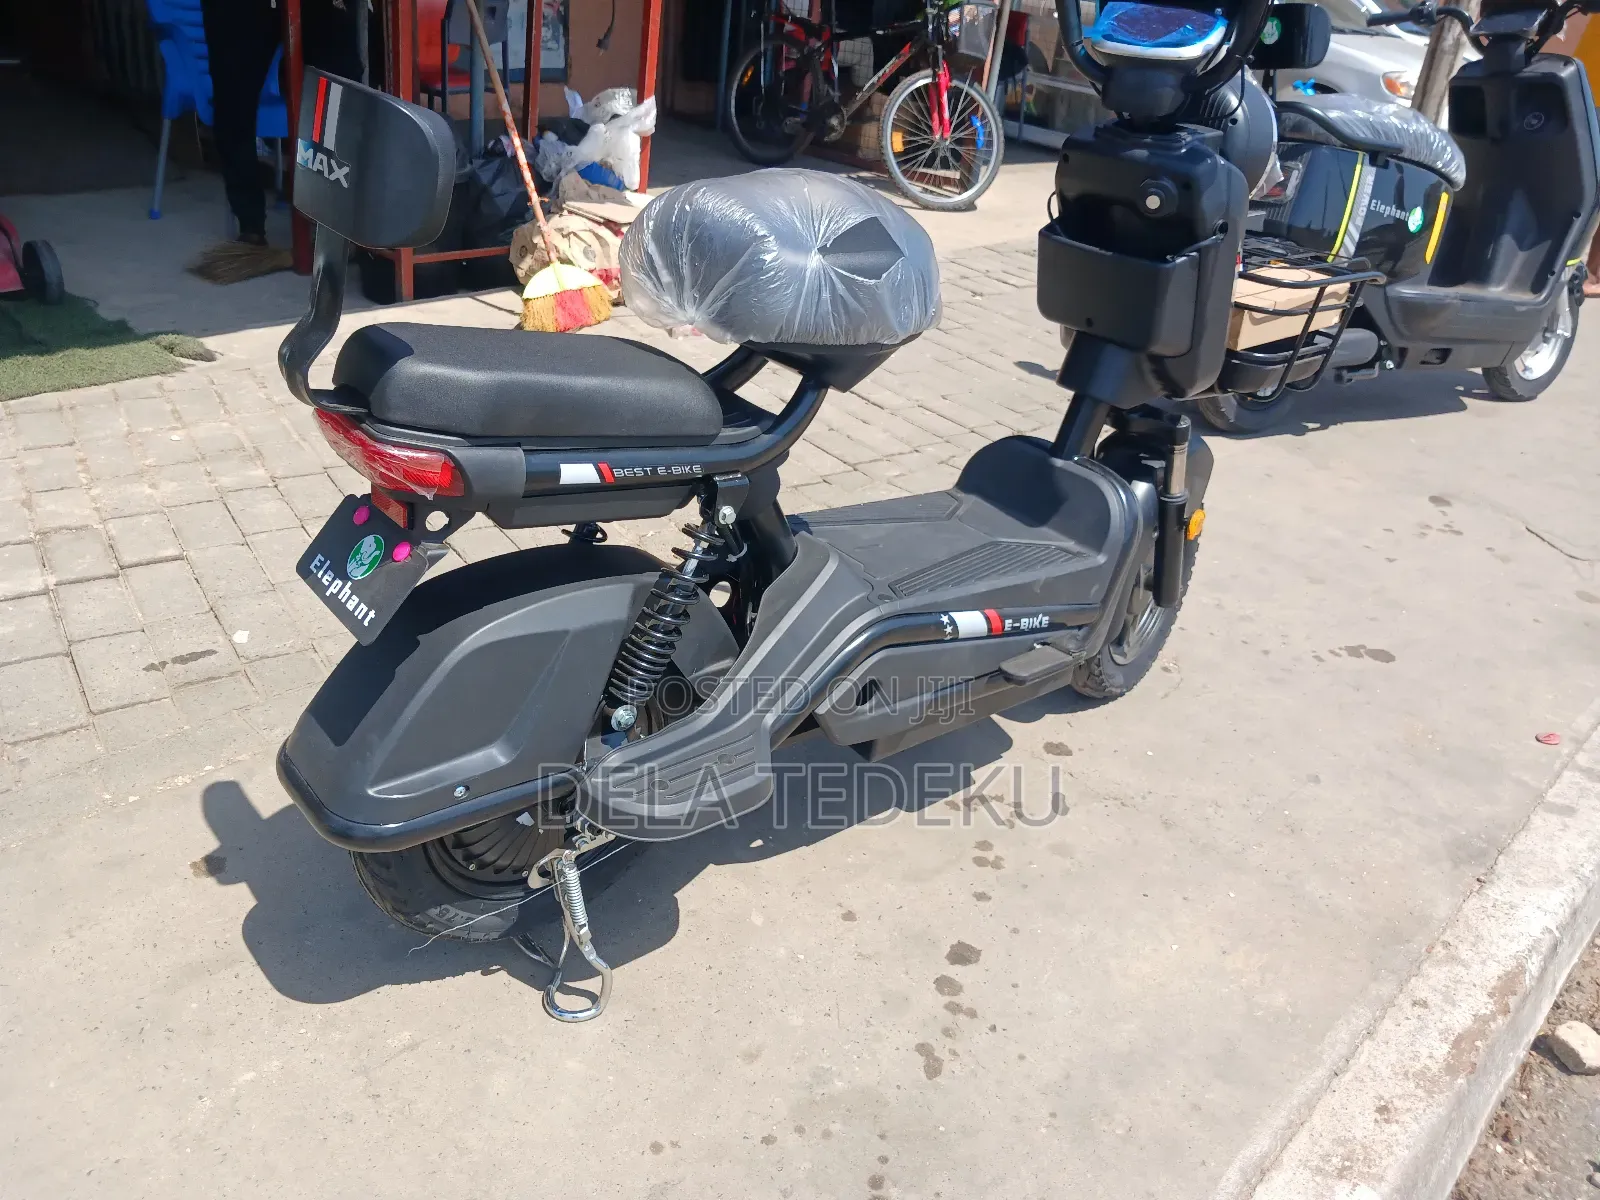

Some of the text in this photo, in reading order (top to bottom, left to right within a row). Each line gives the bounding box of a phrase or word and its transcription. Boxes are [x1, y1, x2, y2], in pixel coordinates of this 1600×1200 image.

[297, 138, 350, 188] MAX
[1355, 174, 1375, 226] POWER
[1370, 199, 1410, 222] Elephant
[612, 464, 702, 477] BEST E-BIKE
[310, 553, 376, 627] Elephant
[1004, 613, 1050, 631] E-BIKE
